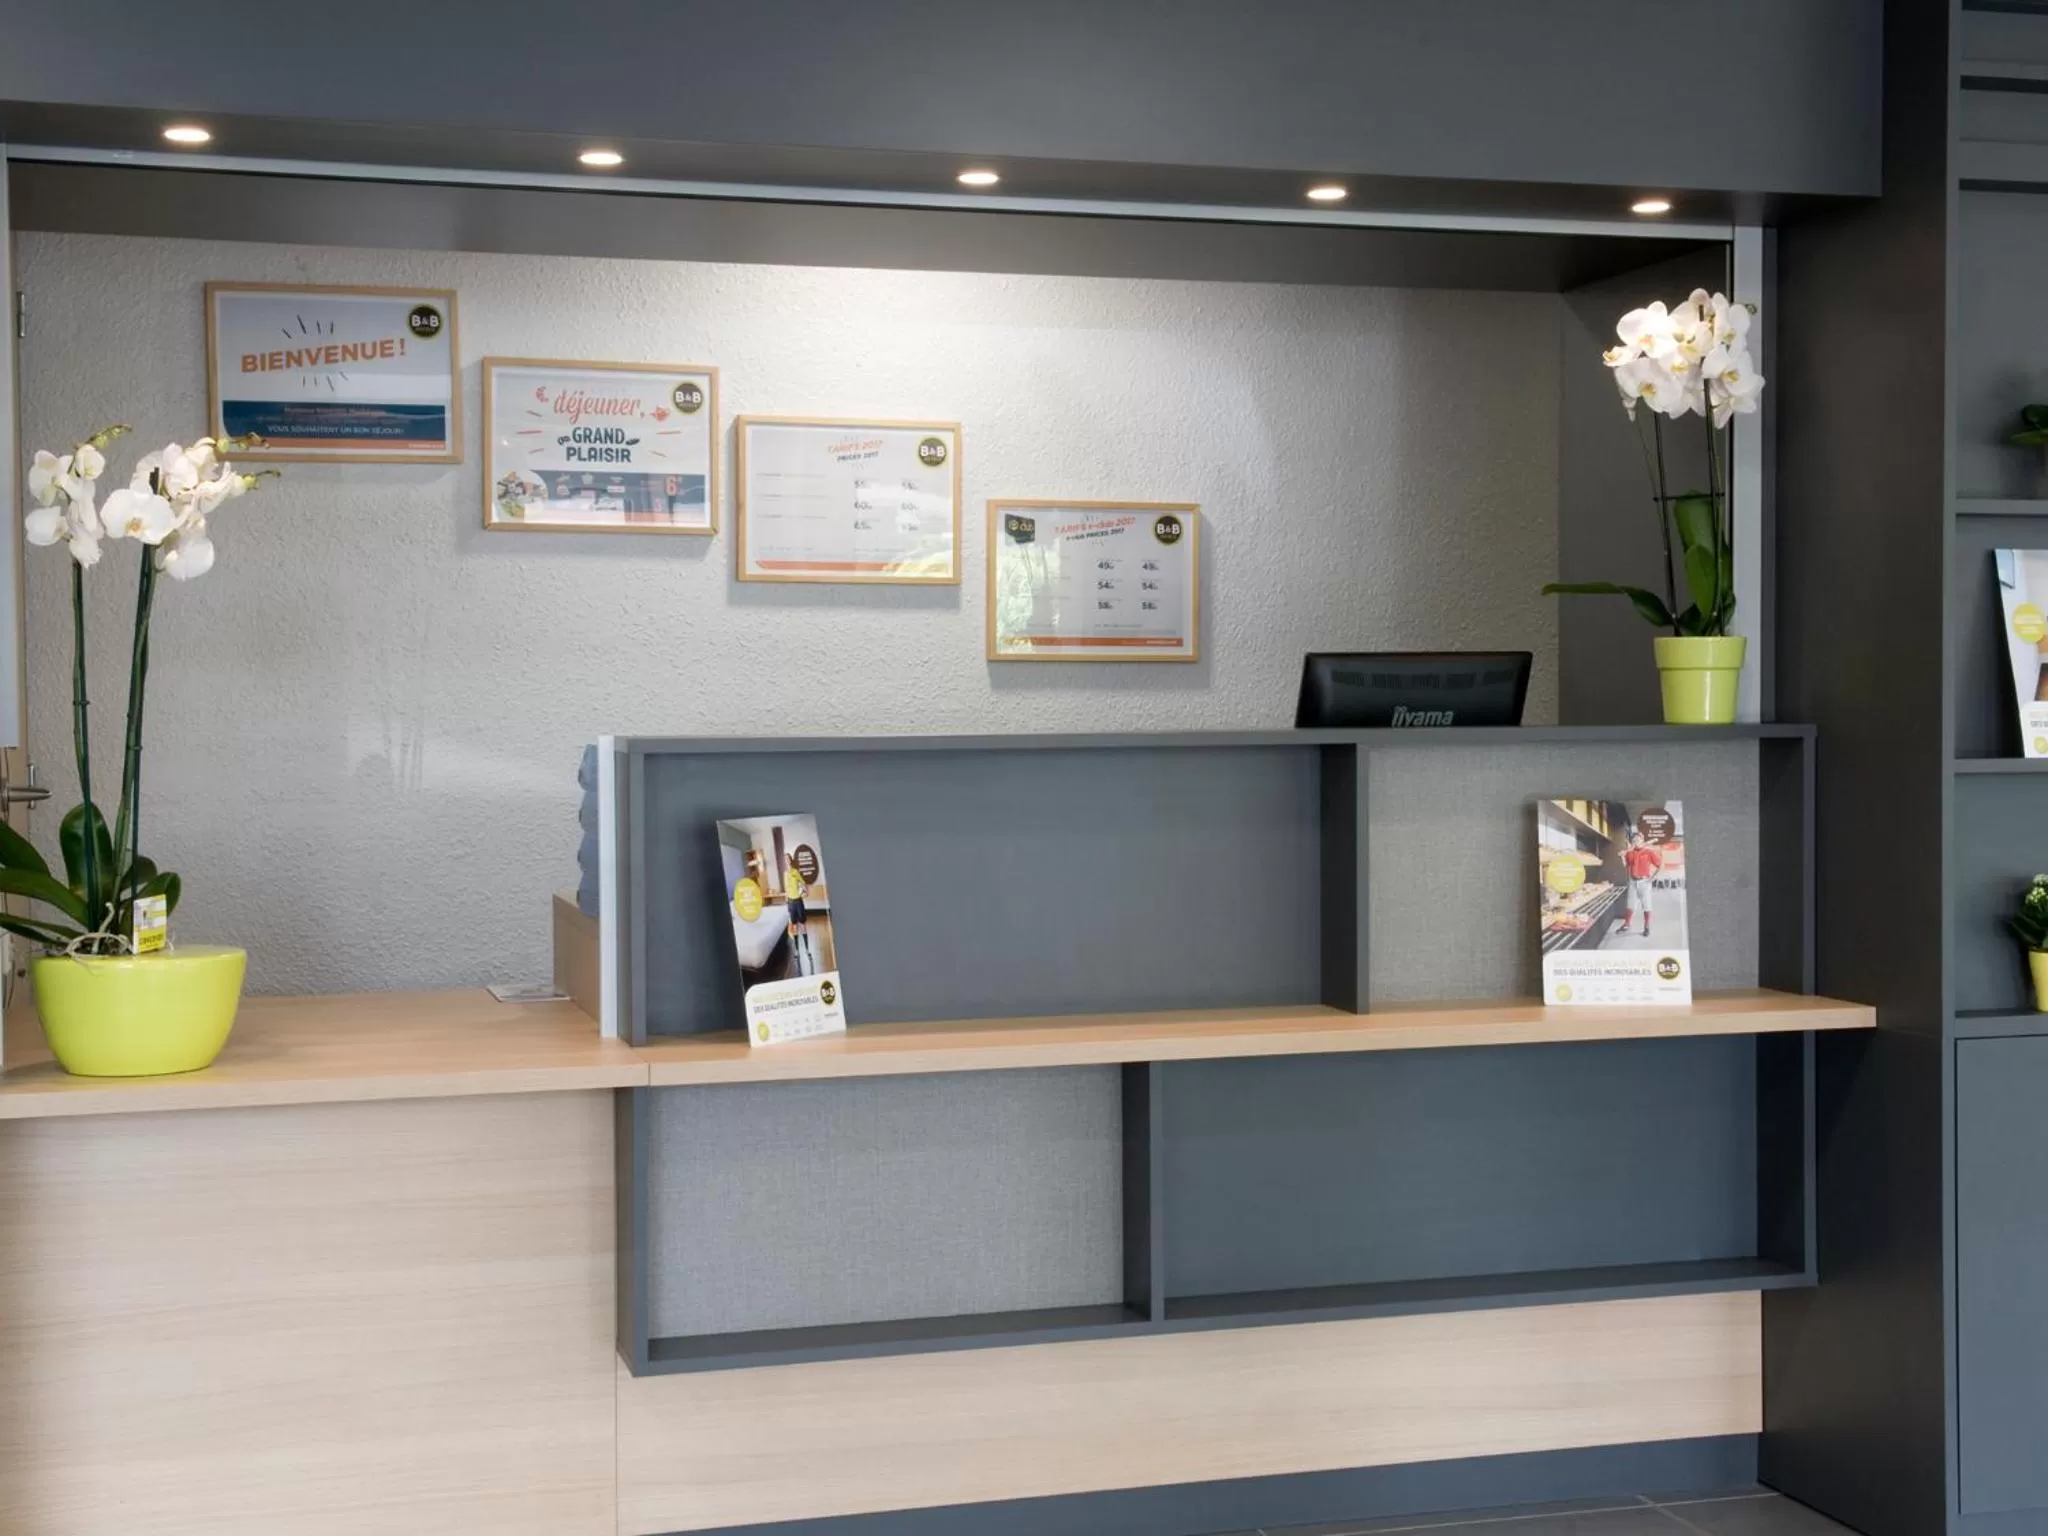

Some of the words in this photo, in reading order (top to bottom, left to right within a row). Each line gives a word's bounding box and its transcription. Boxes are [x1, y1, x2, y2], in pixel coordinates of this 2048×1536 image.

[411, 314, 439, 328] B&B
[675, 391, 702, 403] B&B
[572, 427, 625, 445] GRAND
[566, 446, 632, 463] PLAISIR
[920, 445, 945, 457] B&B
[1157, 523, 1180, 535] B&B
